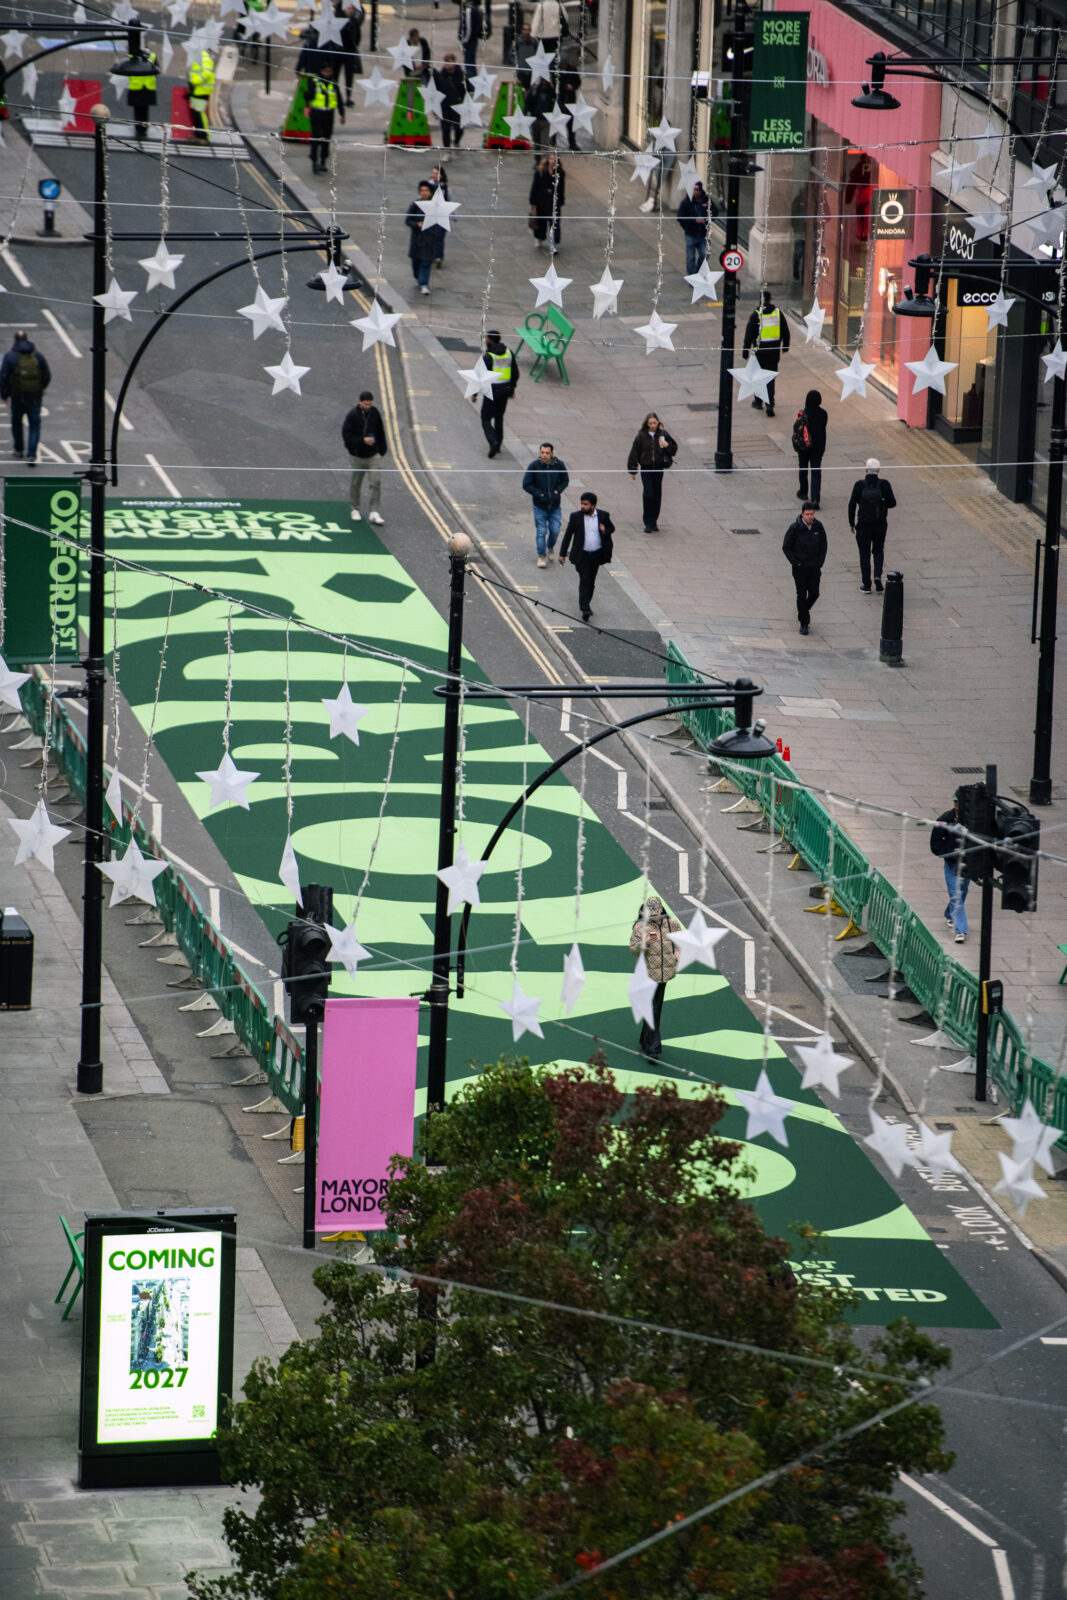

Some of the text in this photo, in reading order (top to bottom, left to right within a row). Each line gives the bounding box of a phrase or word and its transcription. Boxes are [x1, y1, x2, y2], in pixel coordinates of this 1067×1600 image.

[763, 20, 801, 33] MORE
[762, 33, 800, 45] SPACE
[763, 119, 791, 131] LESS
[751, 131, 803, 144] TRAFFIC
[950, 225, 975, 260] ecco
[726, 256, 741, 266] 20
[963, 292, 999, 304] ecco
[104, 509, 316, 521] OXFORD
[172, 519, 272, 531] THE
[279, 521, 352, 533] TO
[321, 1178, 390, 1195] MAYOR
[320, 1196, 389, 1213] LONDO
[946, 1204, 1007, 1235] LOOK
[108, 1247, 215, 1271] COMING
[128, 1367, 189, 1390] 2027
